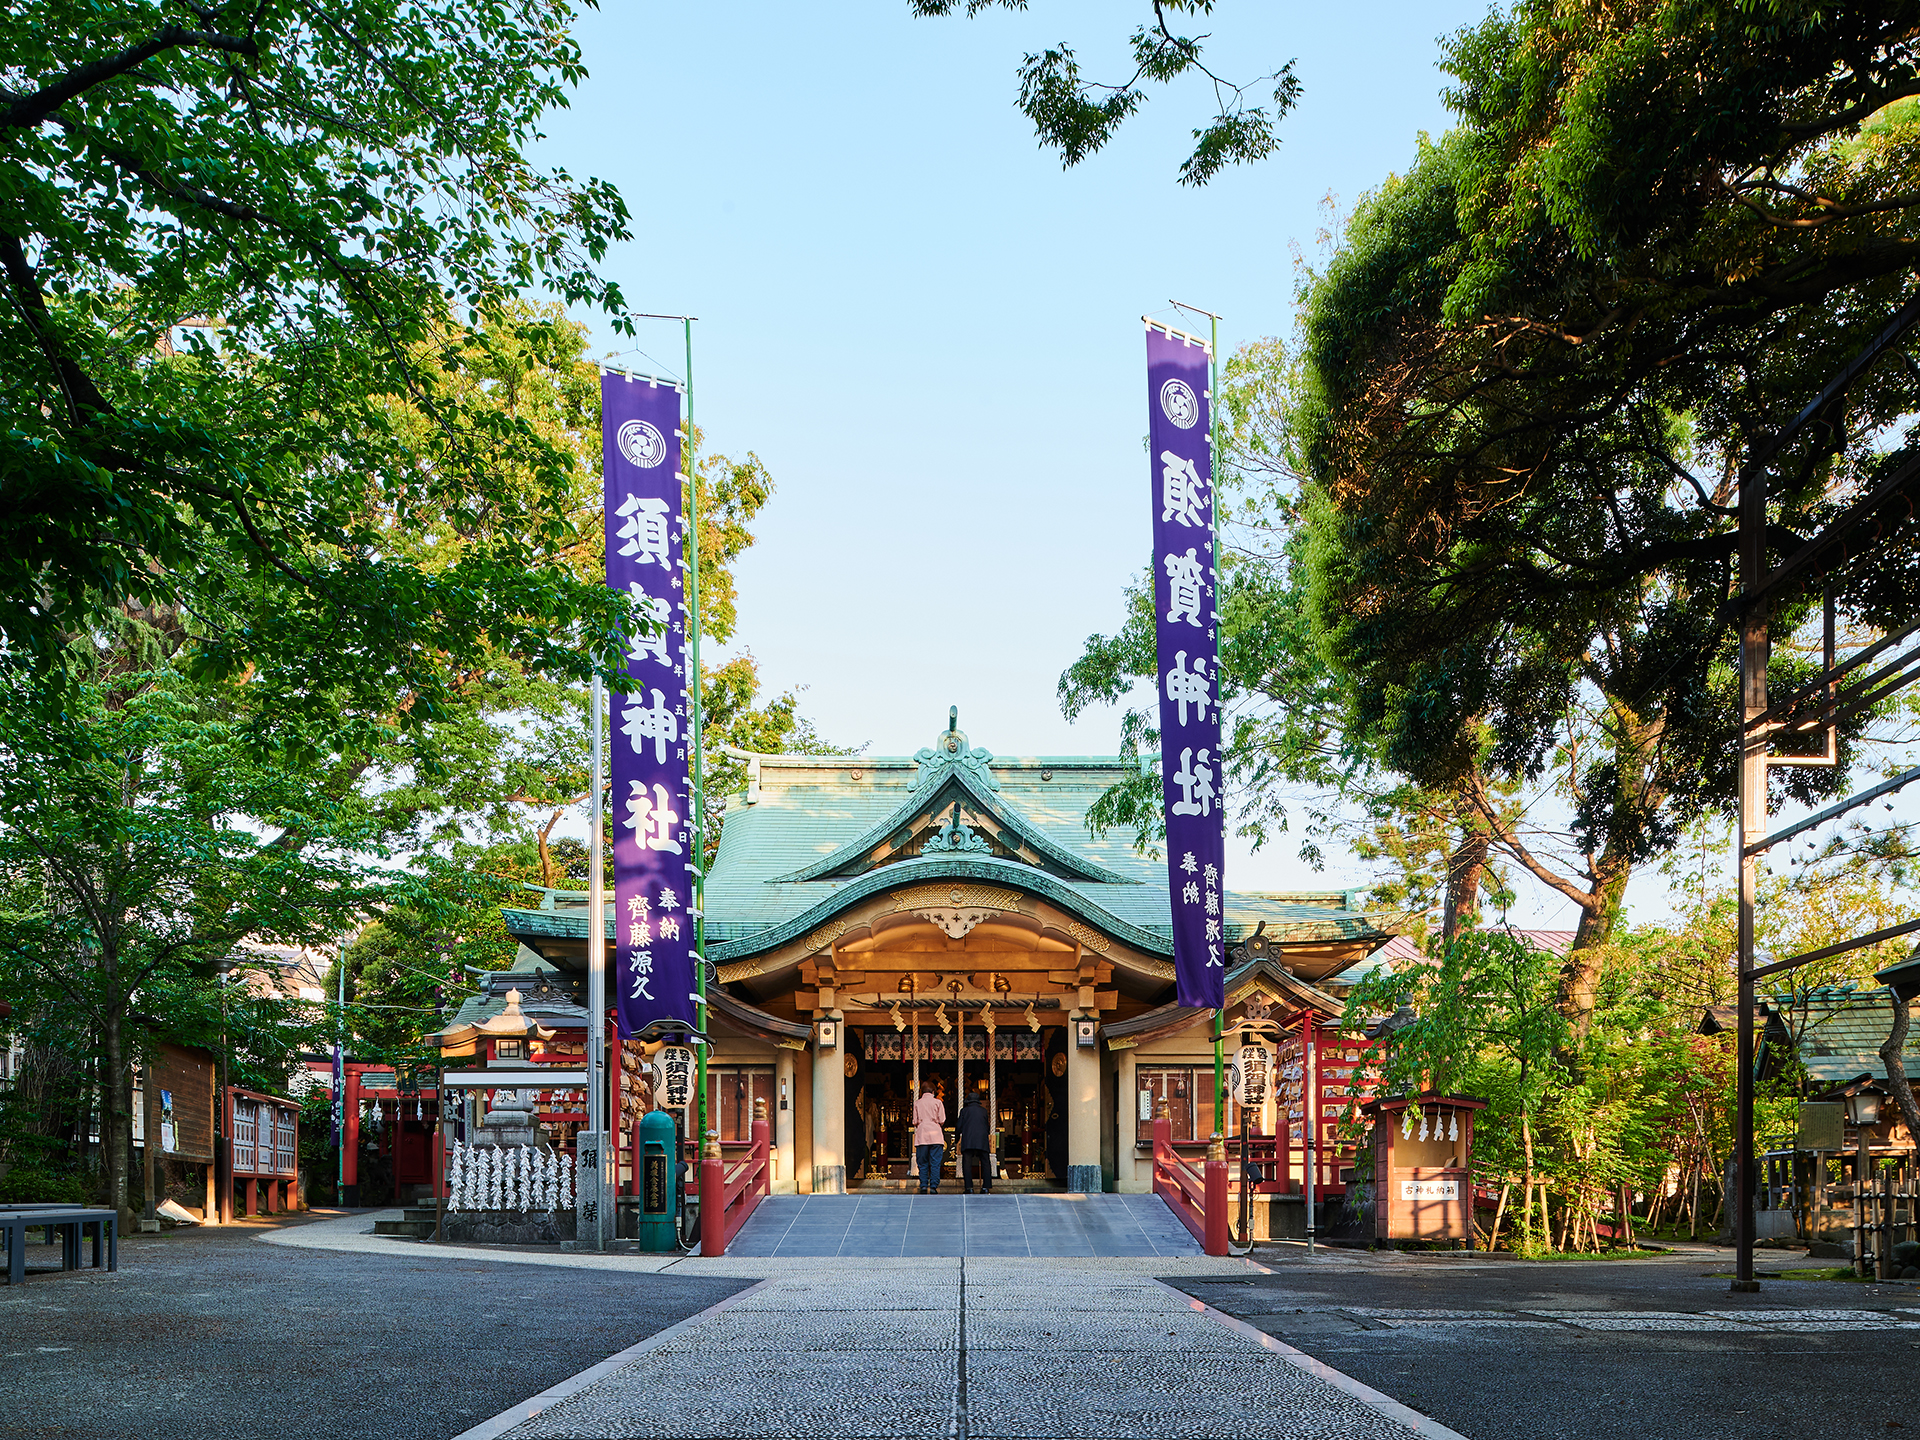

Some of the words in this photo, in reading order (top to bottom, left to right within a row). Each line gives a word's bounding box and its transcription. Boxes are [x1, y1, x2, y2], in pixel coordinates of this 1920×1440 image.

[614, 492, 684, 856] 須賀神社
[669, 531, 687, 844] 令和元年五月一日
[657, 887, 681, 942] 奉納
[665, 1060, 689, 1106] 須賀神社
[1244, 1059, 1267, 1105] 須賀神社
